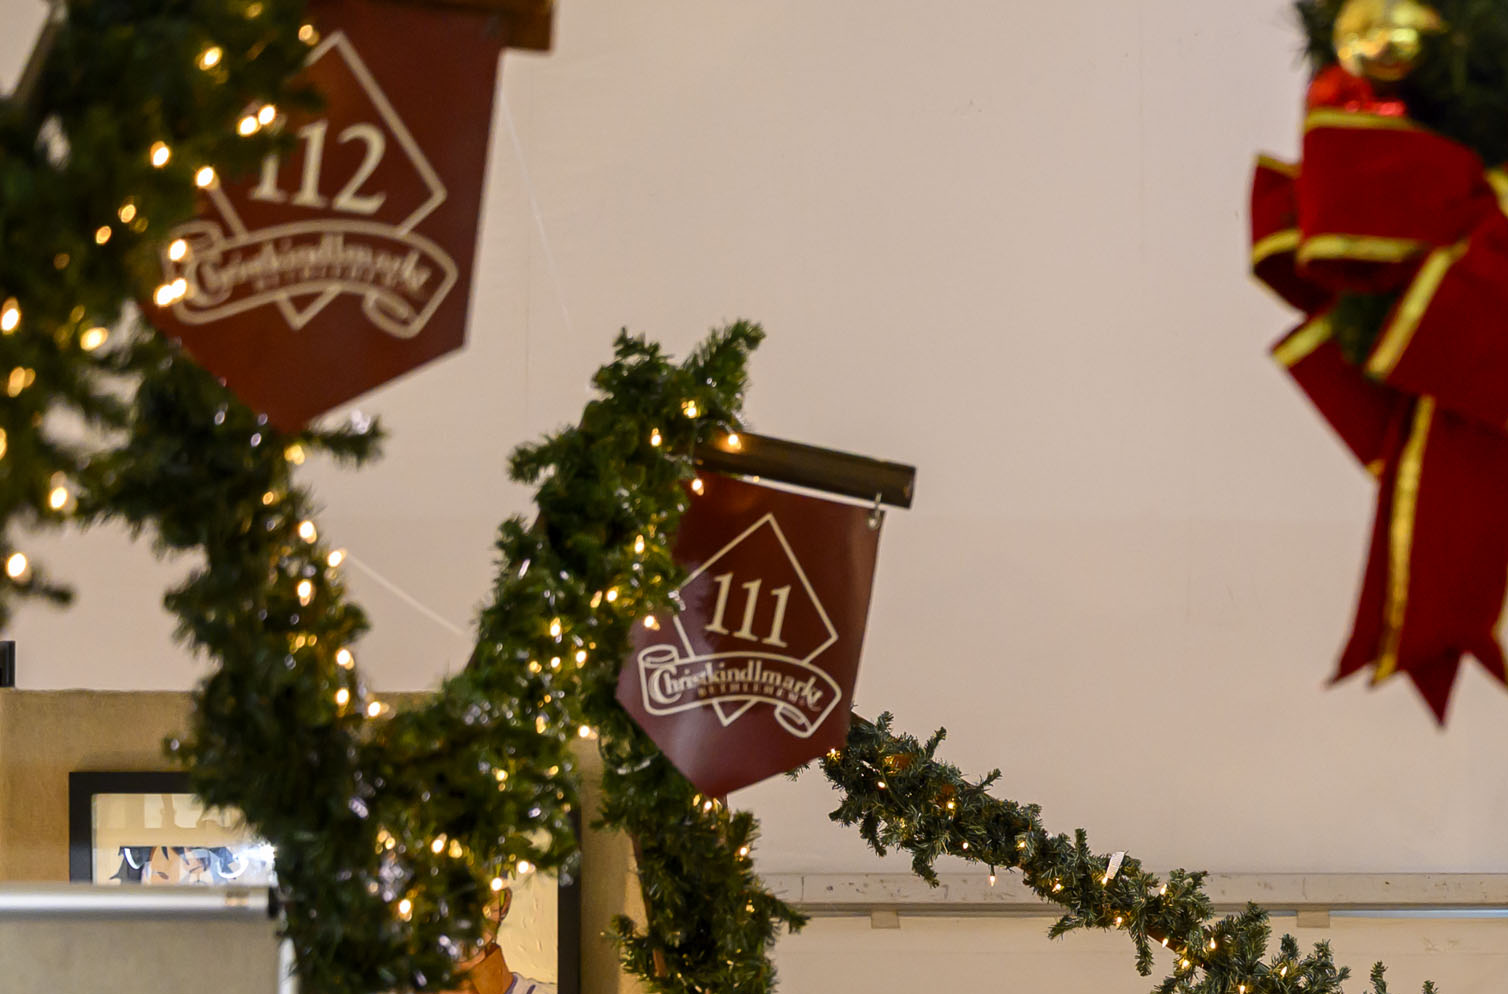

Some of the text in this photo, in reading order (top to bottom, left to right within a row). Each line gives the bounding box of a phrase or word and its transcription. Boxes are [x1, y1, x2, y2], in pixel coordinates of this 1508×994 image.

[249, 118, 387, 215] 112
[704, 571, 792, 648] 111
[649, 660, 825, 712] Christkindlmarkt
